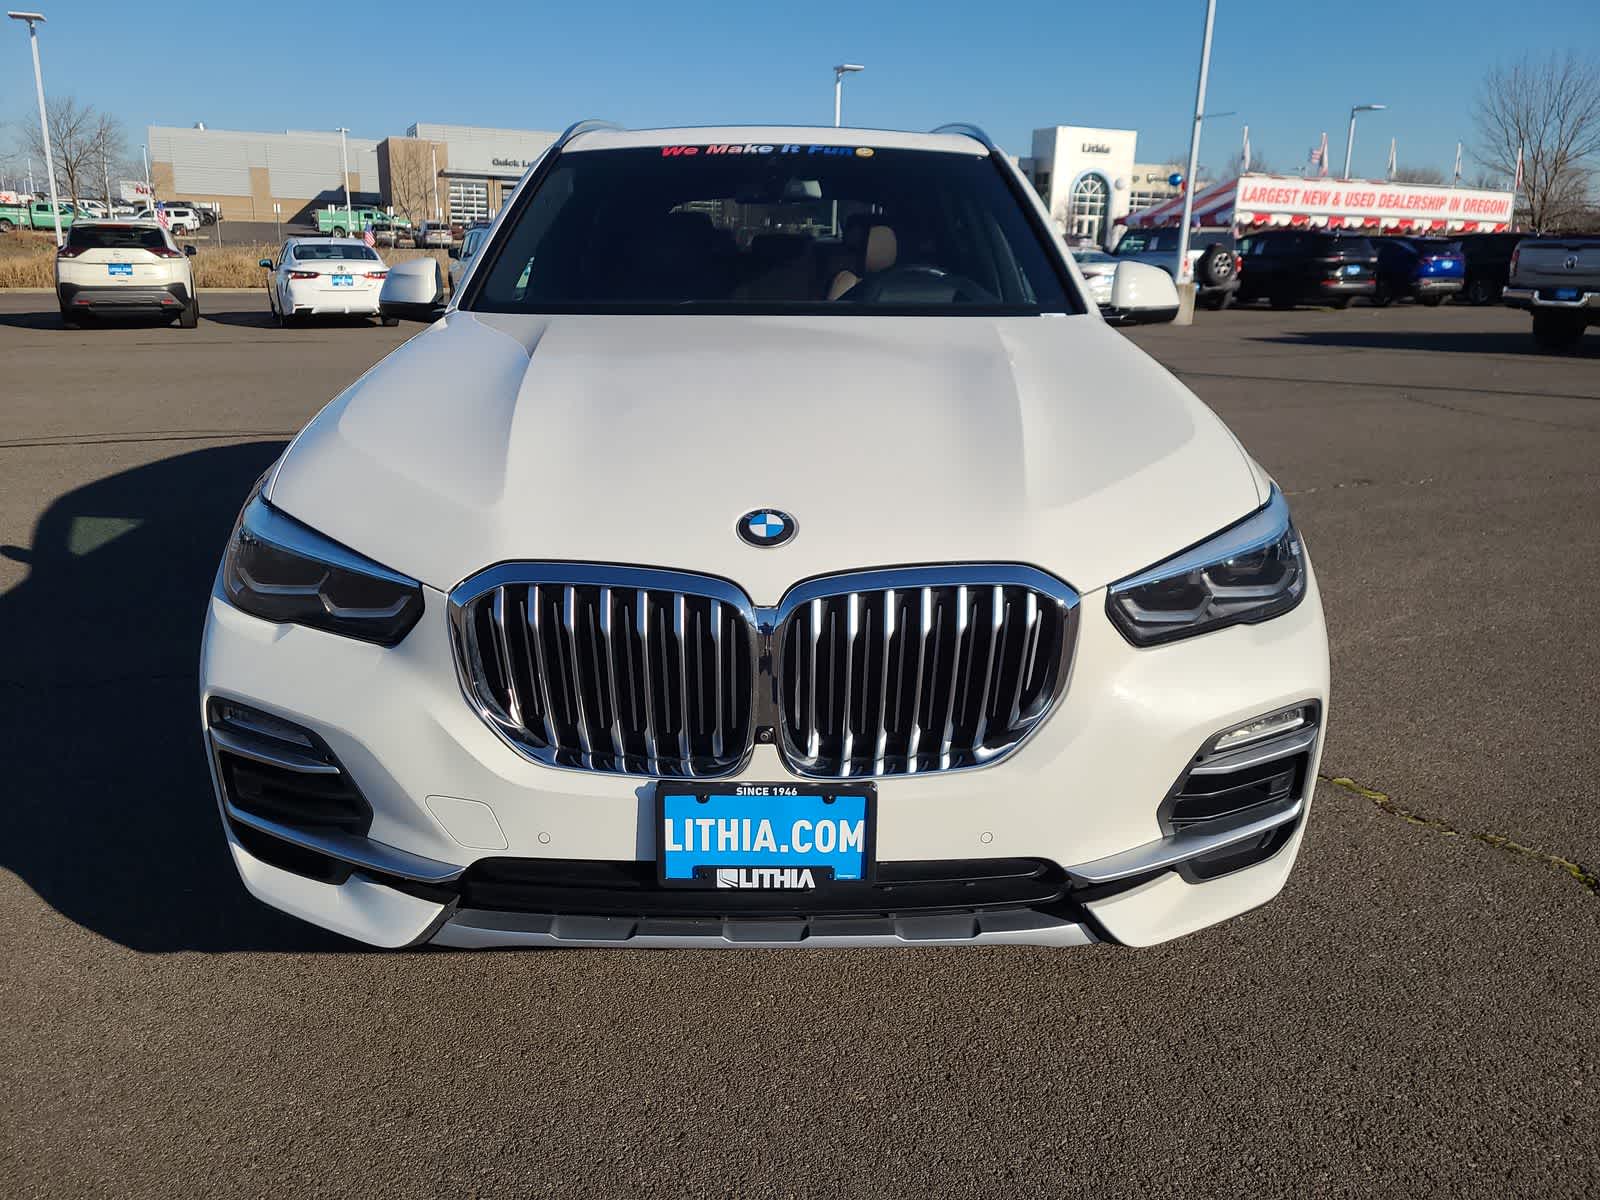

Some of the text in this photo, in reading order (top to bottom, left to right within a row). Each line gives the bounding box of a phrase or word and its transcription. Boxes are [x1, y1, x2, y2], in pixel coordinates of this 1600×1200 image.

[661, 144, 854, 157] We Make It Fun
[1082, 143, 1111, 154] Lithia
[492, 158, 519, 167] Quick
[1241, 186, 1510, 215] LARGEST NEW & USED DEALERSHIP IN OREGON!
[736, 787, 798, 796] SINCE 1946
[664, 818, 865, 853] LITHIA.COM
[739, 868, 816, 889] LITHIA
